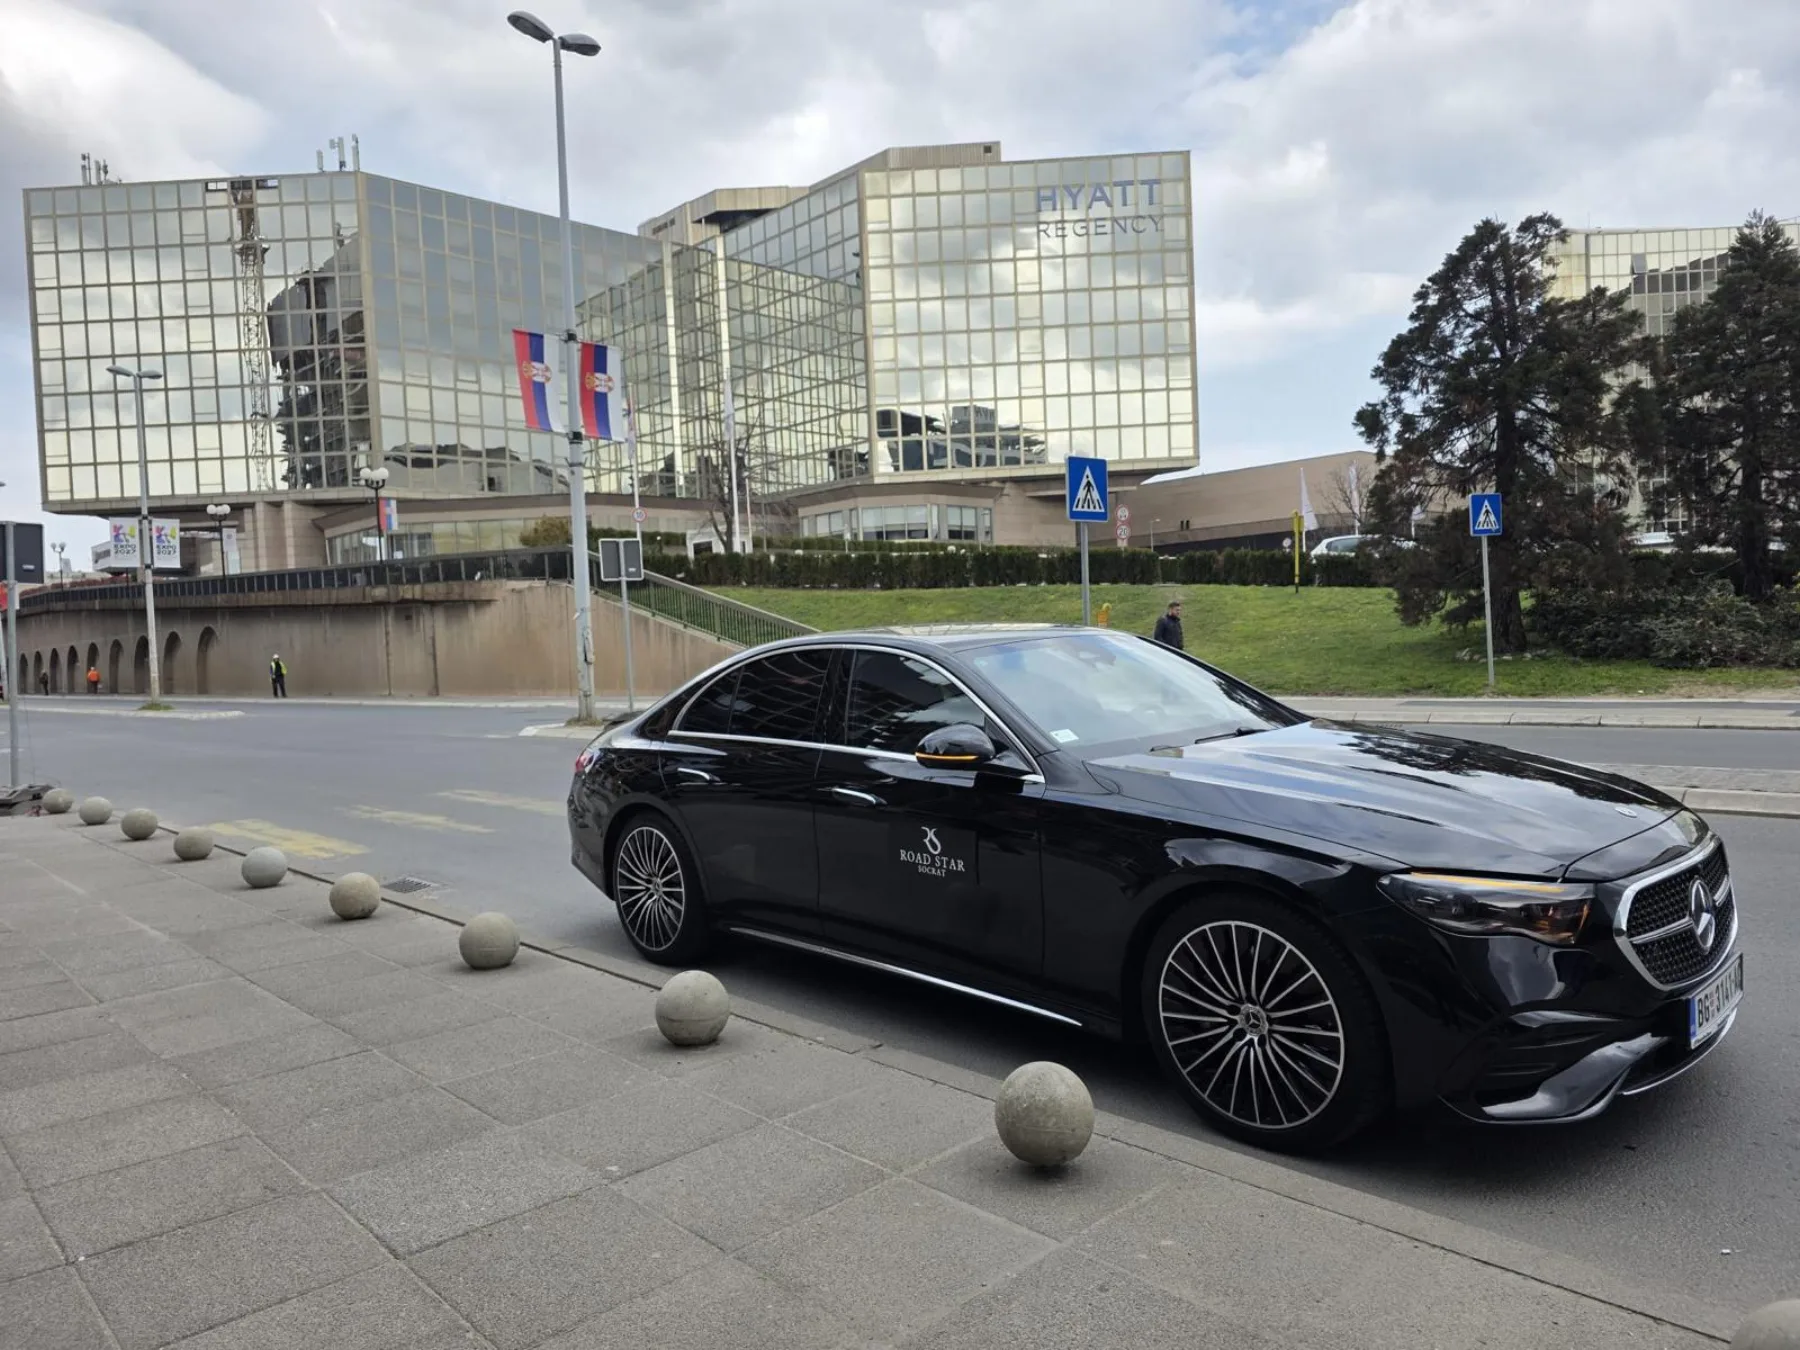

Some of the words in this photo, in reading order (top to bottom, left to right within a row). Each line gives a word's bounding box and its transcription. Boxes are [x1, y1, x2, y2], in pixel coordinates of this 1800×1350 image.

[1037, 179, 1161, 212] HYATT
[1037, 215, 1164, 238] REGENCY
[900, 849, 931, 865] ROAD
[935, 856, 965, 872] STAR
[1698, 994, 1709, 1027] BG
